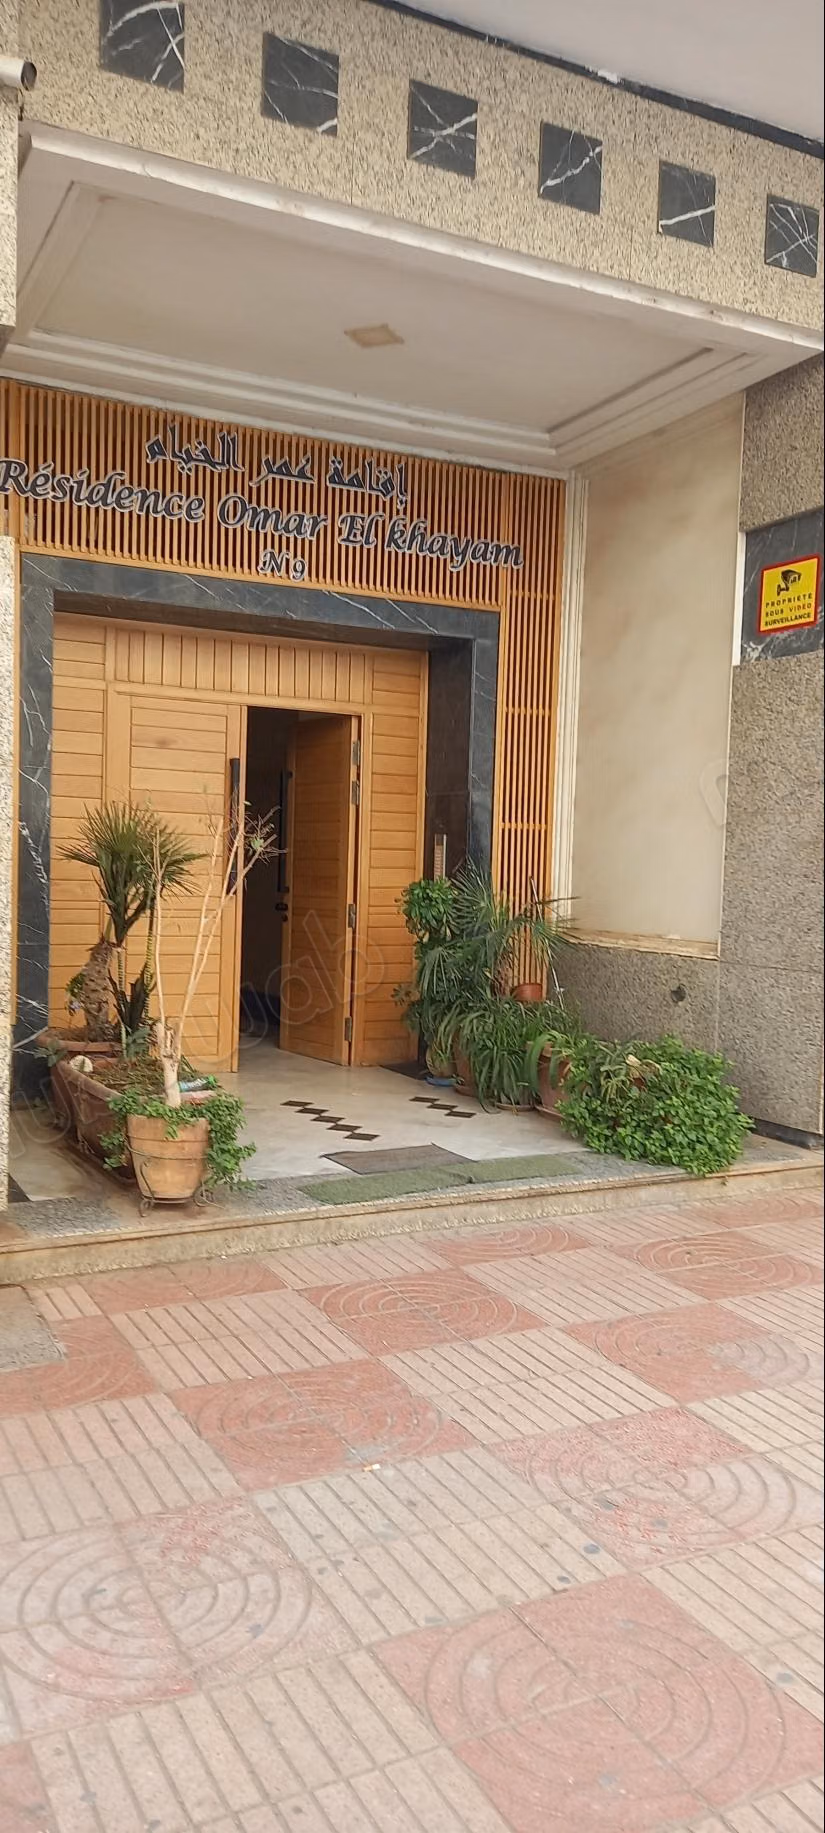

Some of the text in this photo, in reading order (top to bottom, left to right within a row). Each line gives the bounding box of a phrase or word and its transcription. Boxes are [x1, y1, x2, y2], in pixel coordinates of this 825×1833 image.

[146, 423, 245, 475] الخيام
[0, 458, 524, 571] Résidence Omar El khayam
[764, 612, 811, 626] SURVEILLANCE
[765, 608, 784, 617] SOUS
